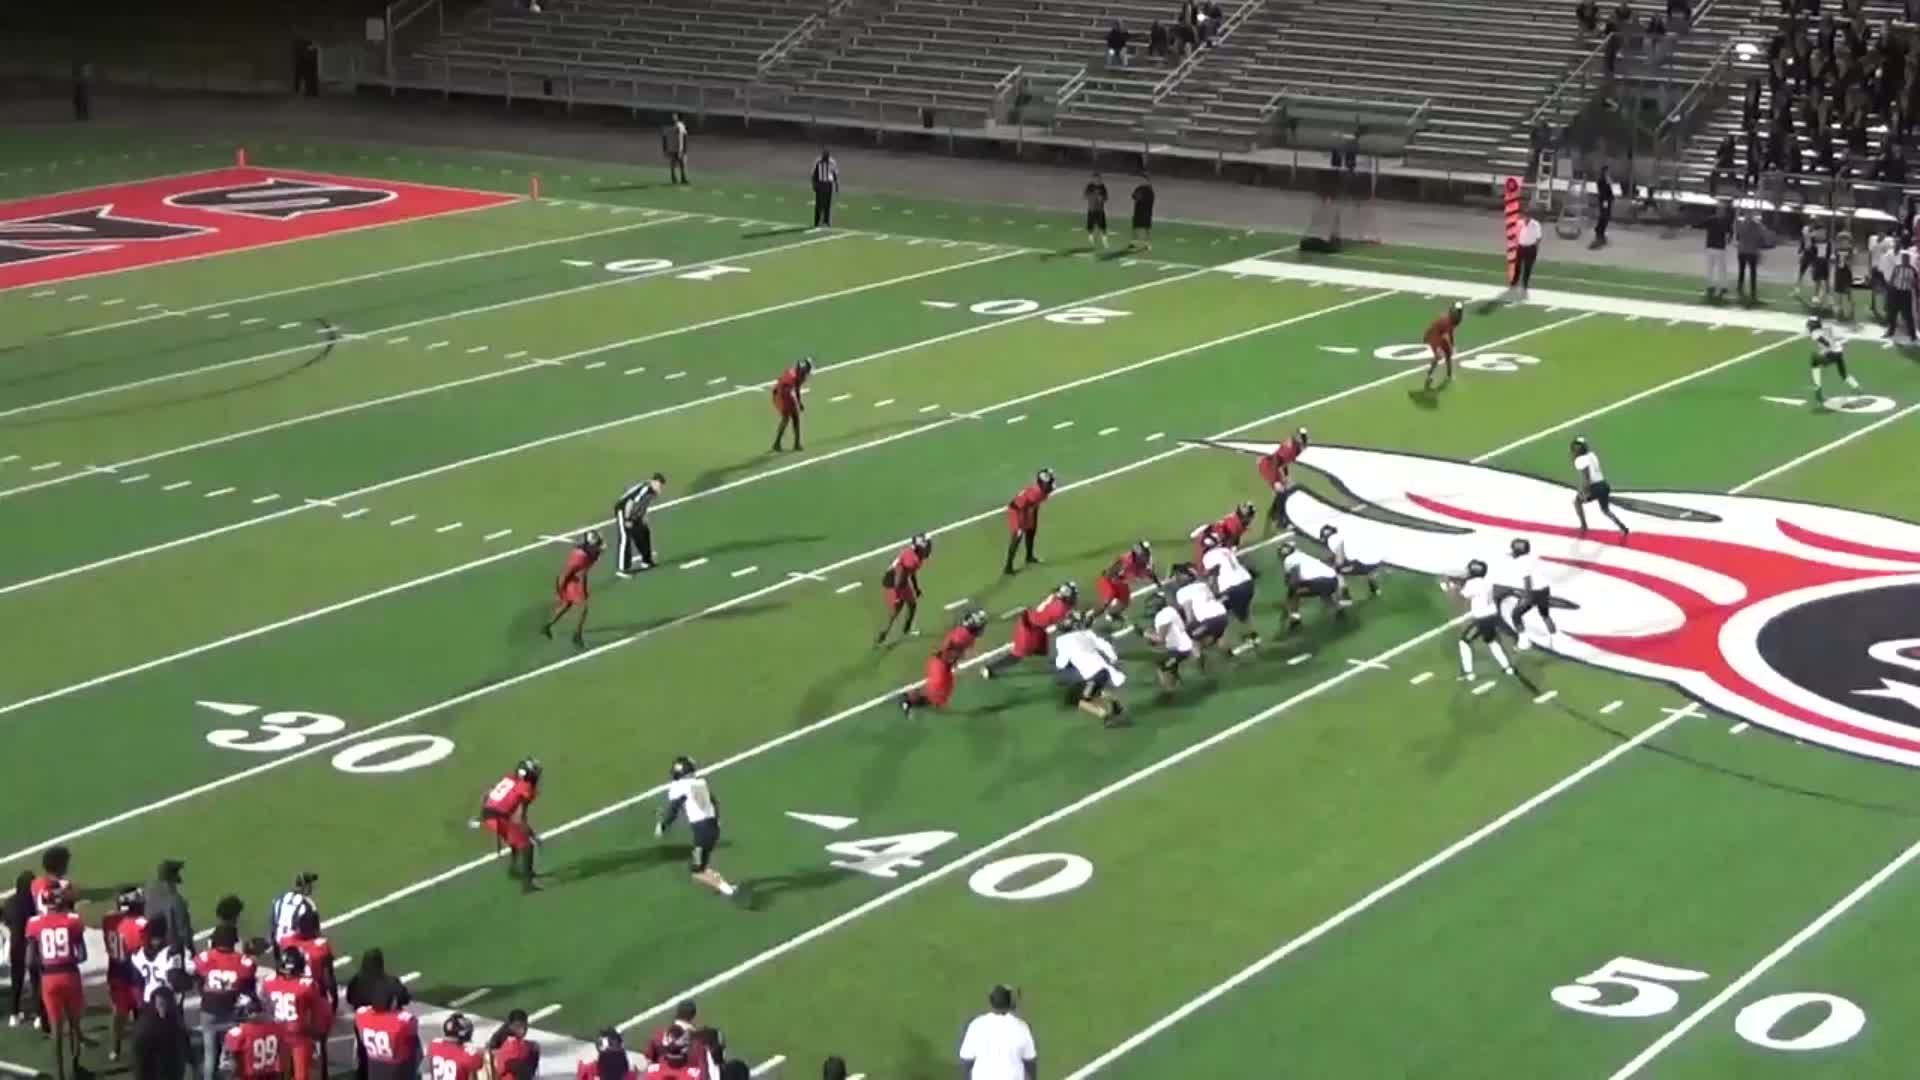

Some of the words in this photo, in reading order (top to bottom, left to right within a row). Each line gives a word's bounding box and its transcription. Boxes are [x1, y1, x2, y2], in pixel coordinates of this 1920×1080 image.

[206, 710, 455, 774] 30
[825, 829, 1094, 901] 40
[40, 927, 70, 960] 89
[270, 990, 299, 1022] 36
[1549, 956, 1868, 1052] 50
[252, 1034, 279, 1070] 99
[361, 1028, 394, 1058] 58
